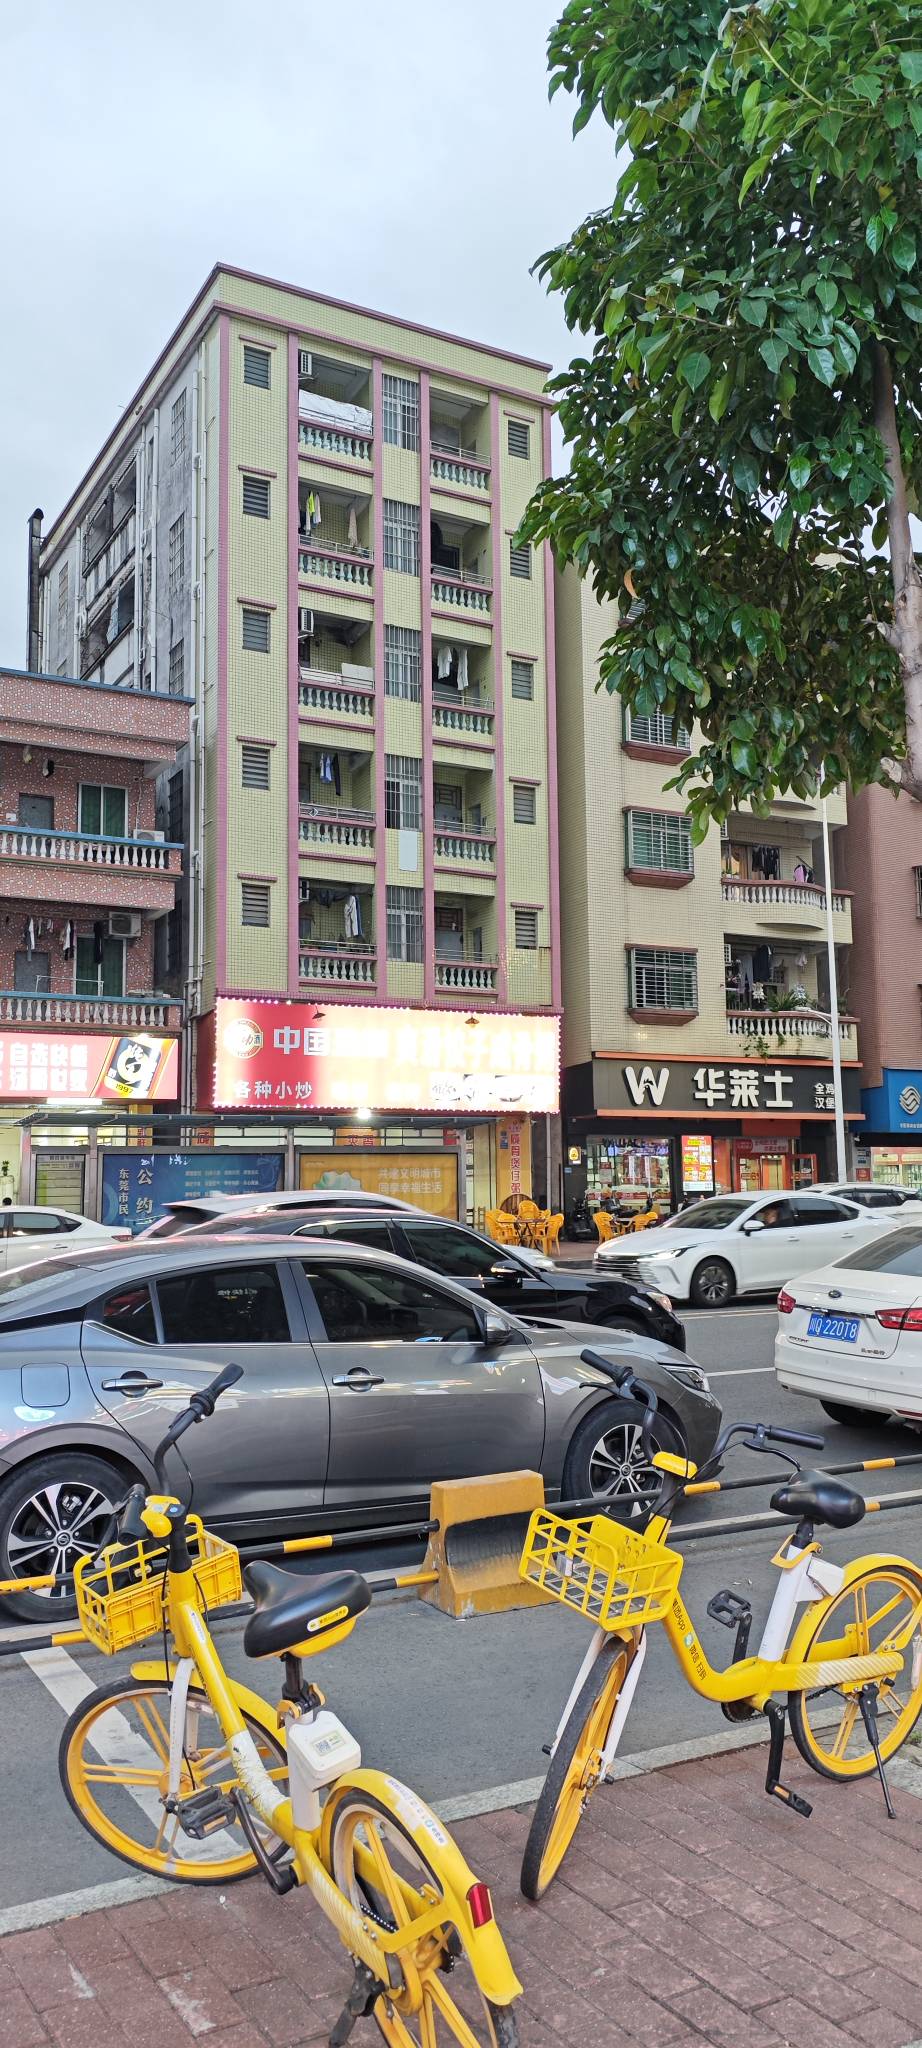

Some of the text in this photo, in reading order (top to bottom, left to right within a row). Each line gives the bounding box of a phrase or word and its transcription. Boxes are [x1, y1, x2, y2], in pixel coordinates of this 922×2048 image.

[235, 1080, 313, 1100] 各种小炒
[624, 1066, 670, 1106] W
[693, 1067, 794, 1108] 华莱士
[118, 1168, 130, 1215] 东莞市民
[136, 1168, 154, 1214] 公约
